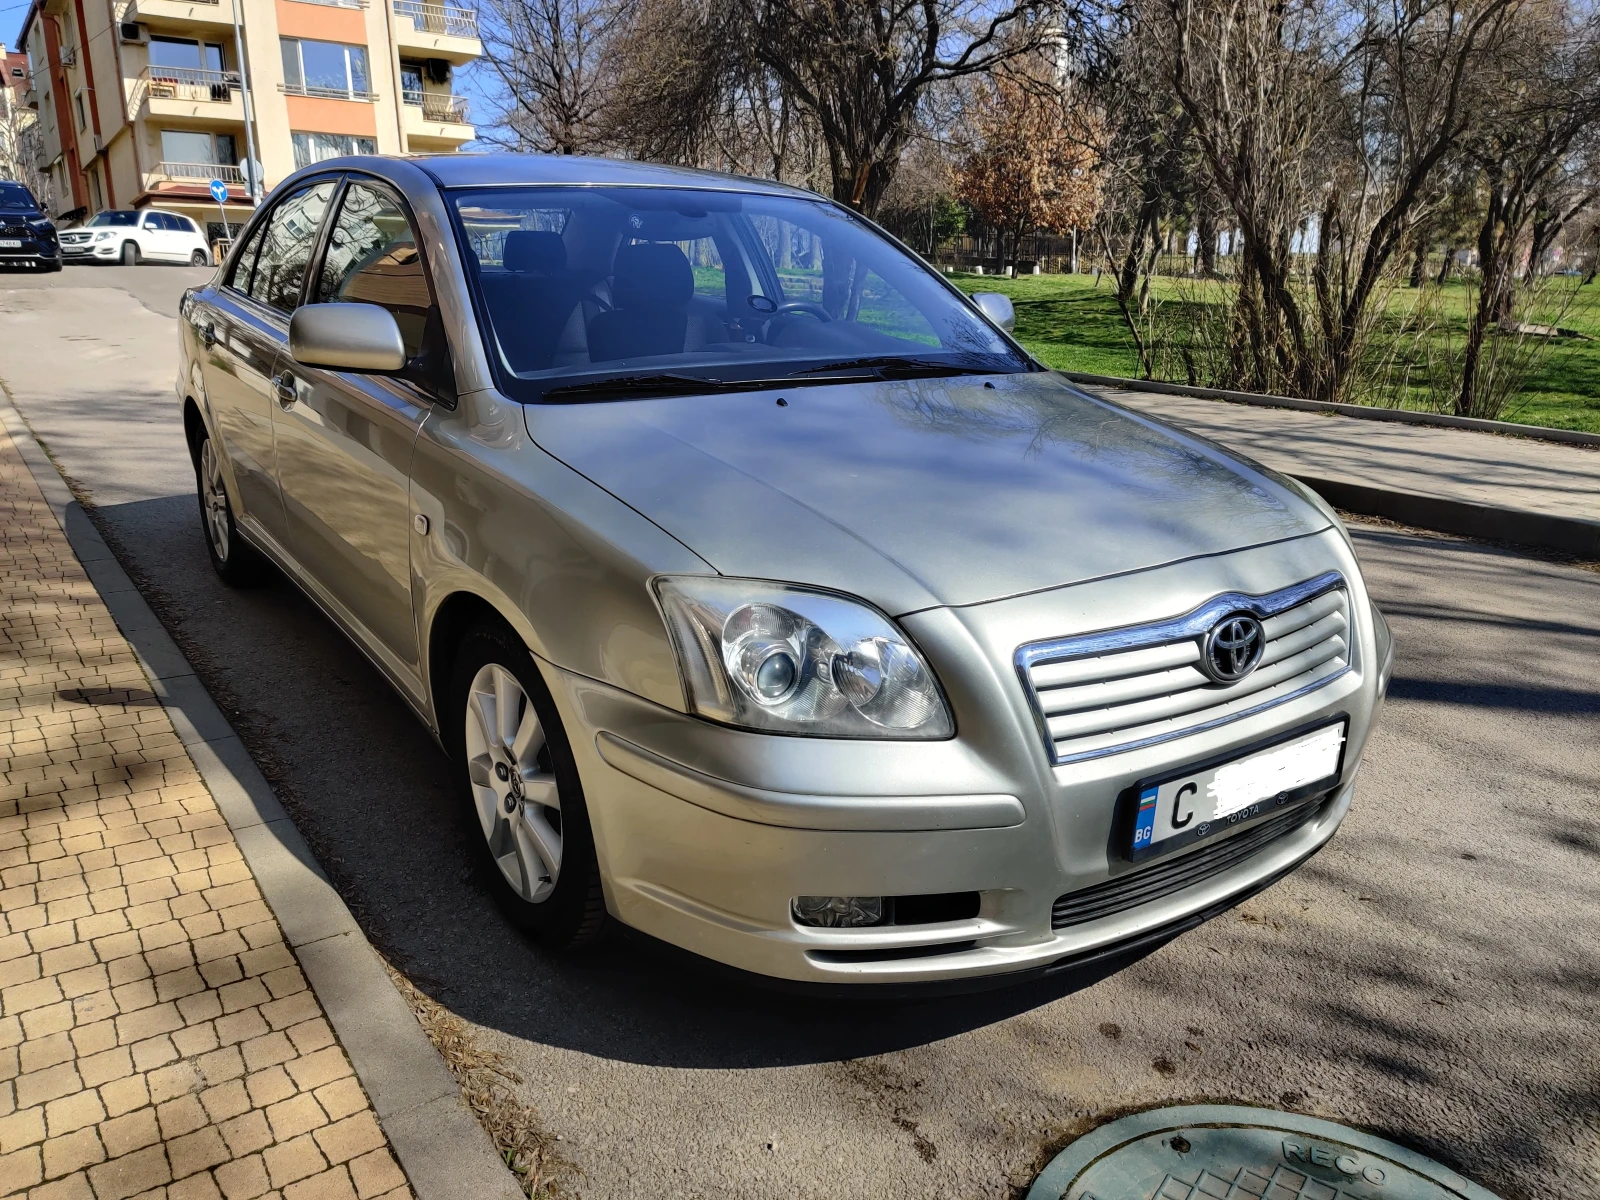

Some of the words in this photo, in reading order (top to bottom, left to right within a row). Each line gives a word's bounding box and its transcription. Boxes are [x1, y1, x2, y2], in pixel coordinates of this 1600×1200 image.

[1171, 781, 1198, 830] C
[1226, 804, 1260, 826] TOYOTA
[1134, 825, 1152, 844] BG
[1281, 1139, 1391, 1187] RECO
